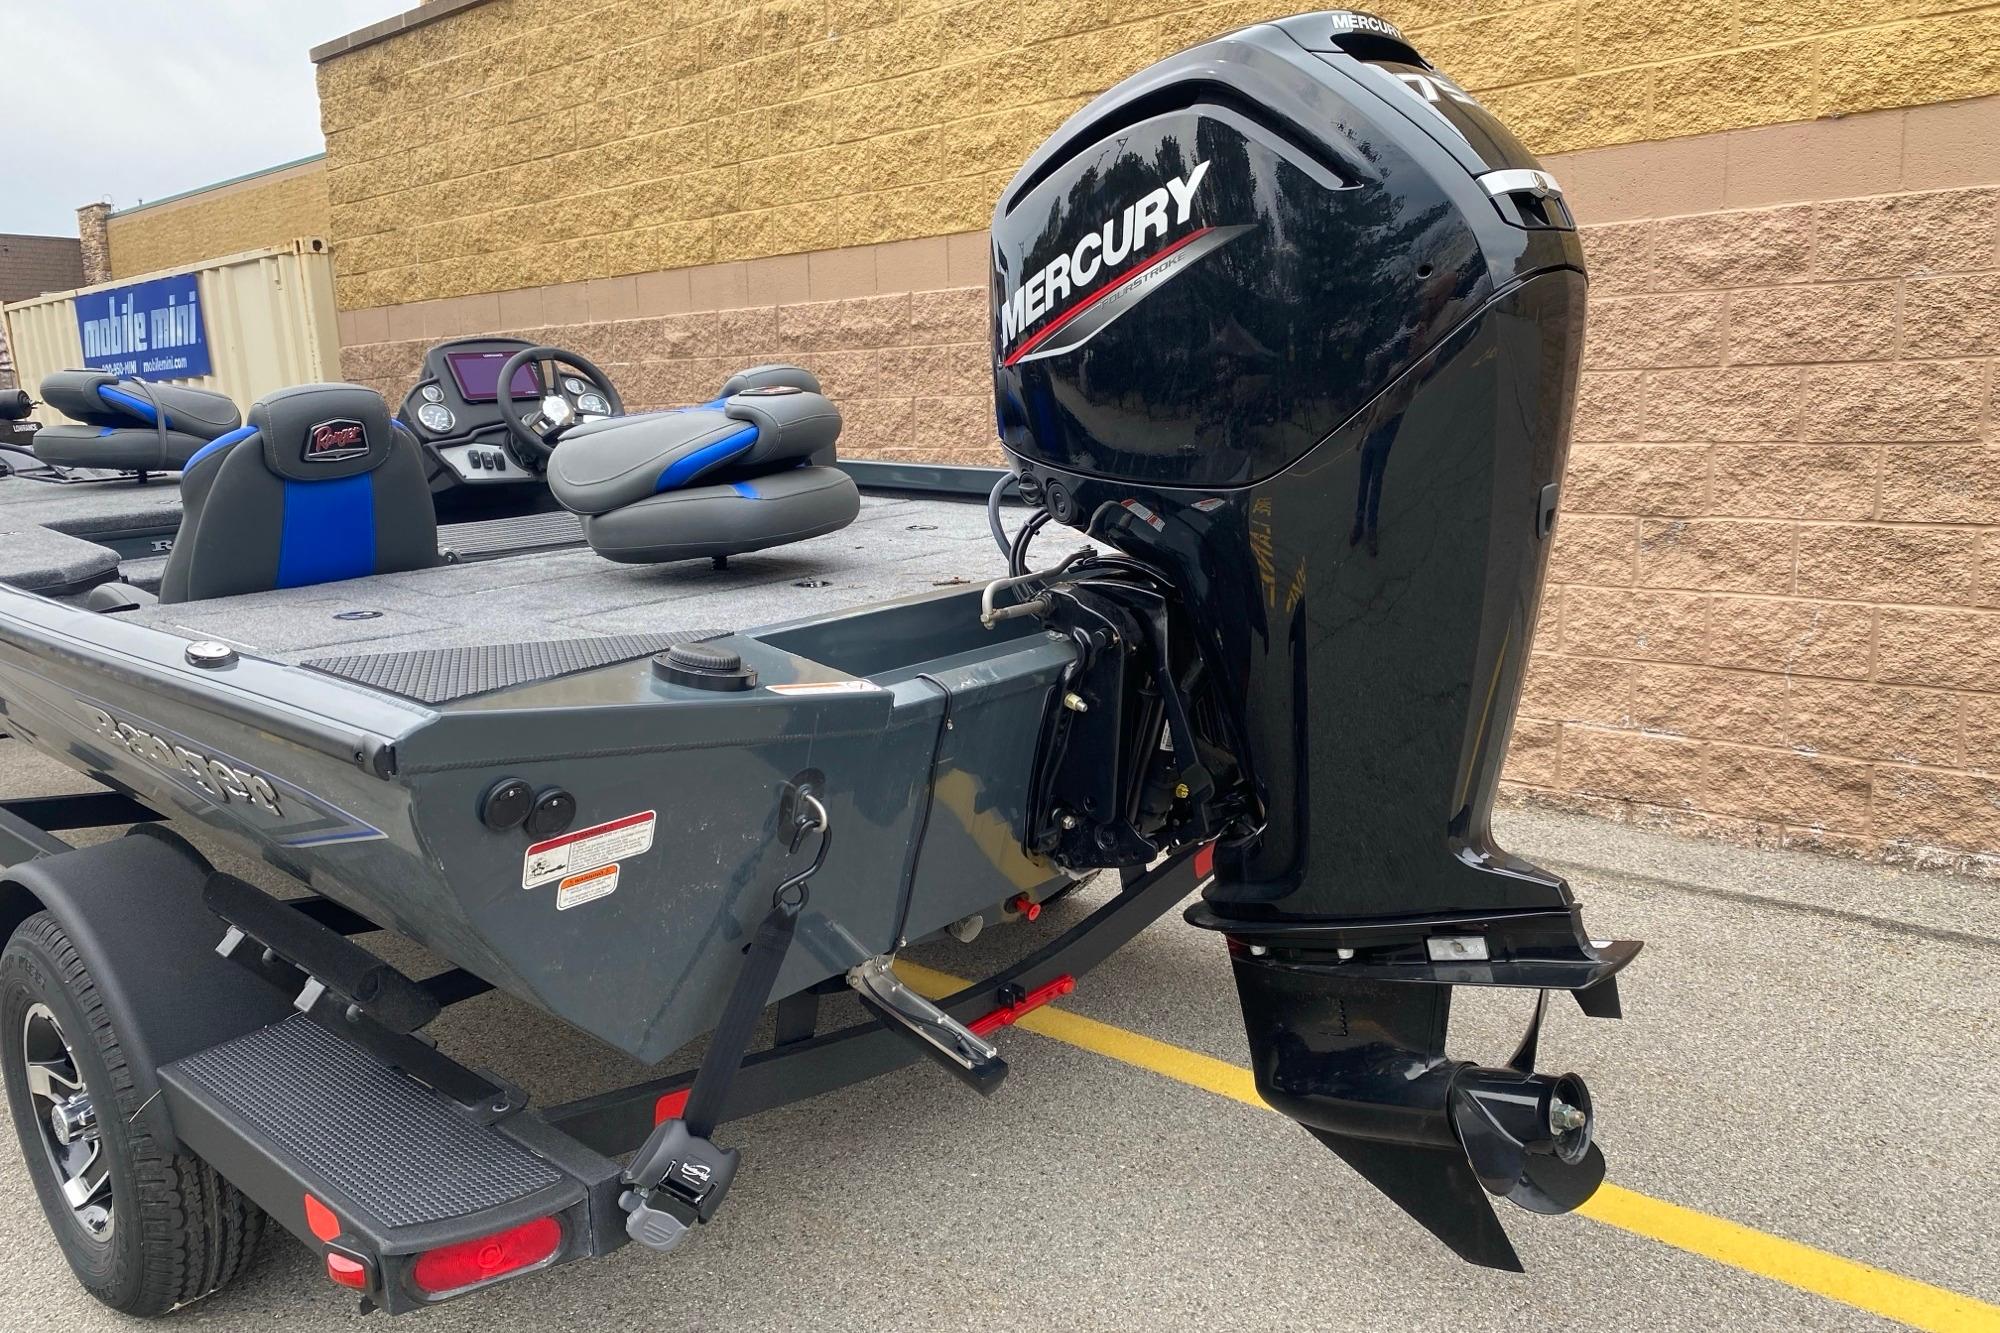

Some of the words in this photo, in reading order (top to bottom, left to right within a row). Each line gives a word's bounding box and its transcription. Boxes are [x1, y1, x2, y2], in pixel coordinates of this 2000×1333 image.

[1331, 14, 1403, 39] MERCURY
[1001, 159, 1211, 349] MERCURY
[1100, 251, 1187, 310] FOURSTROKE
[83, 292, 148, 359] mobile
[150, 290, 197, 350] mini
[143, 356, 188, 373] mobilemini.com
